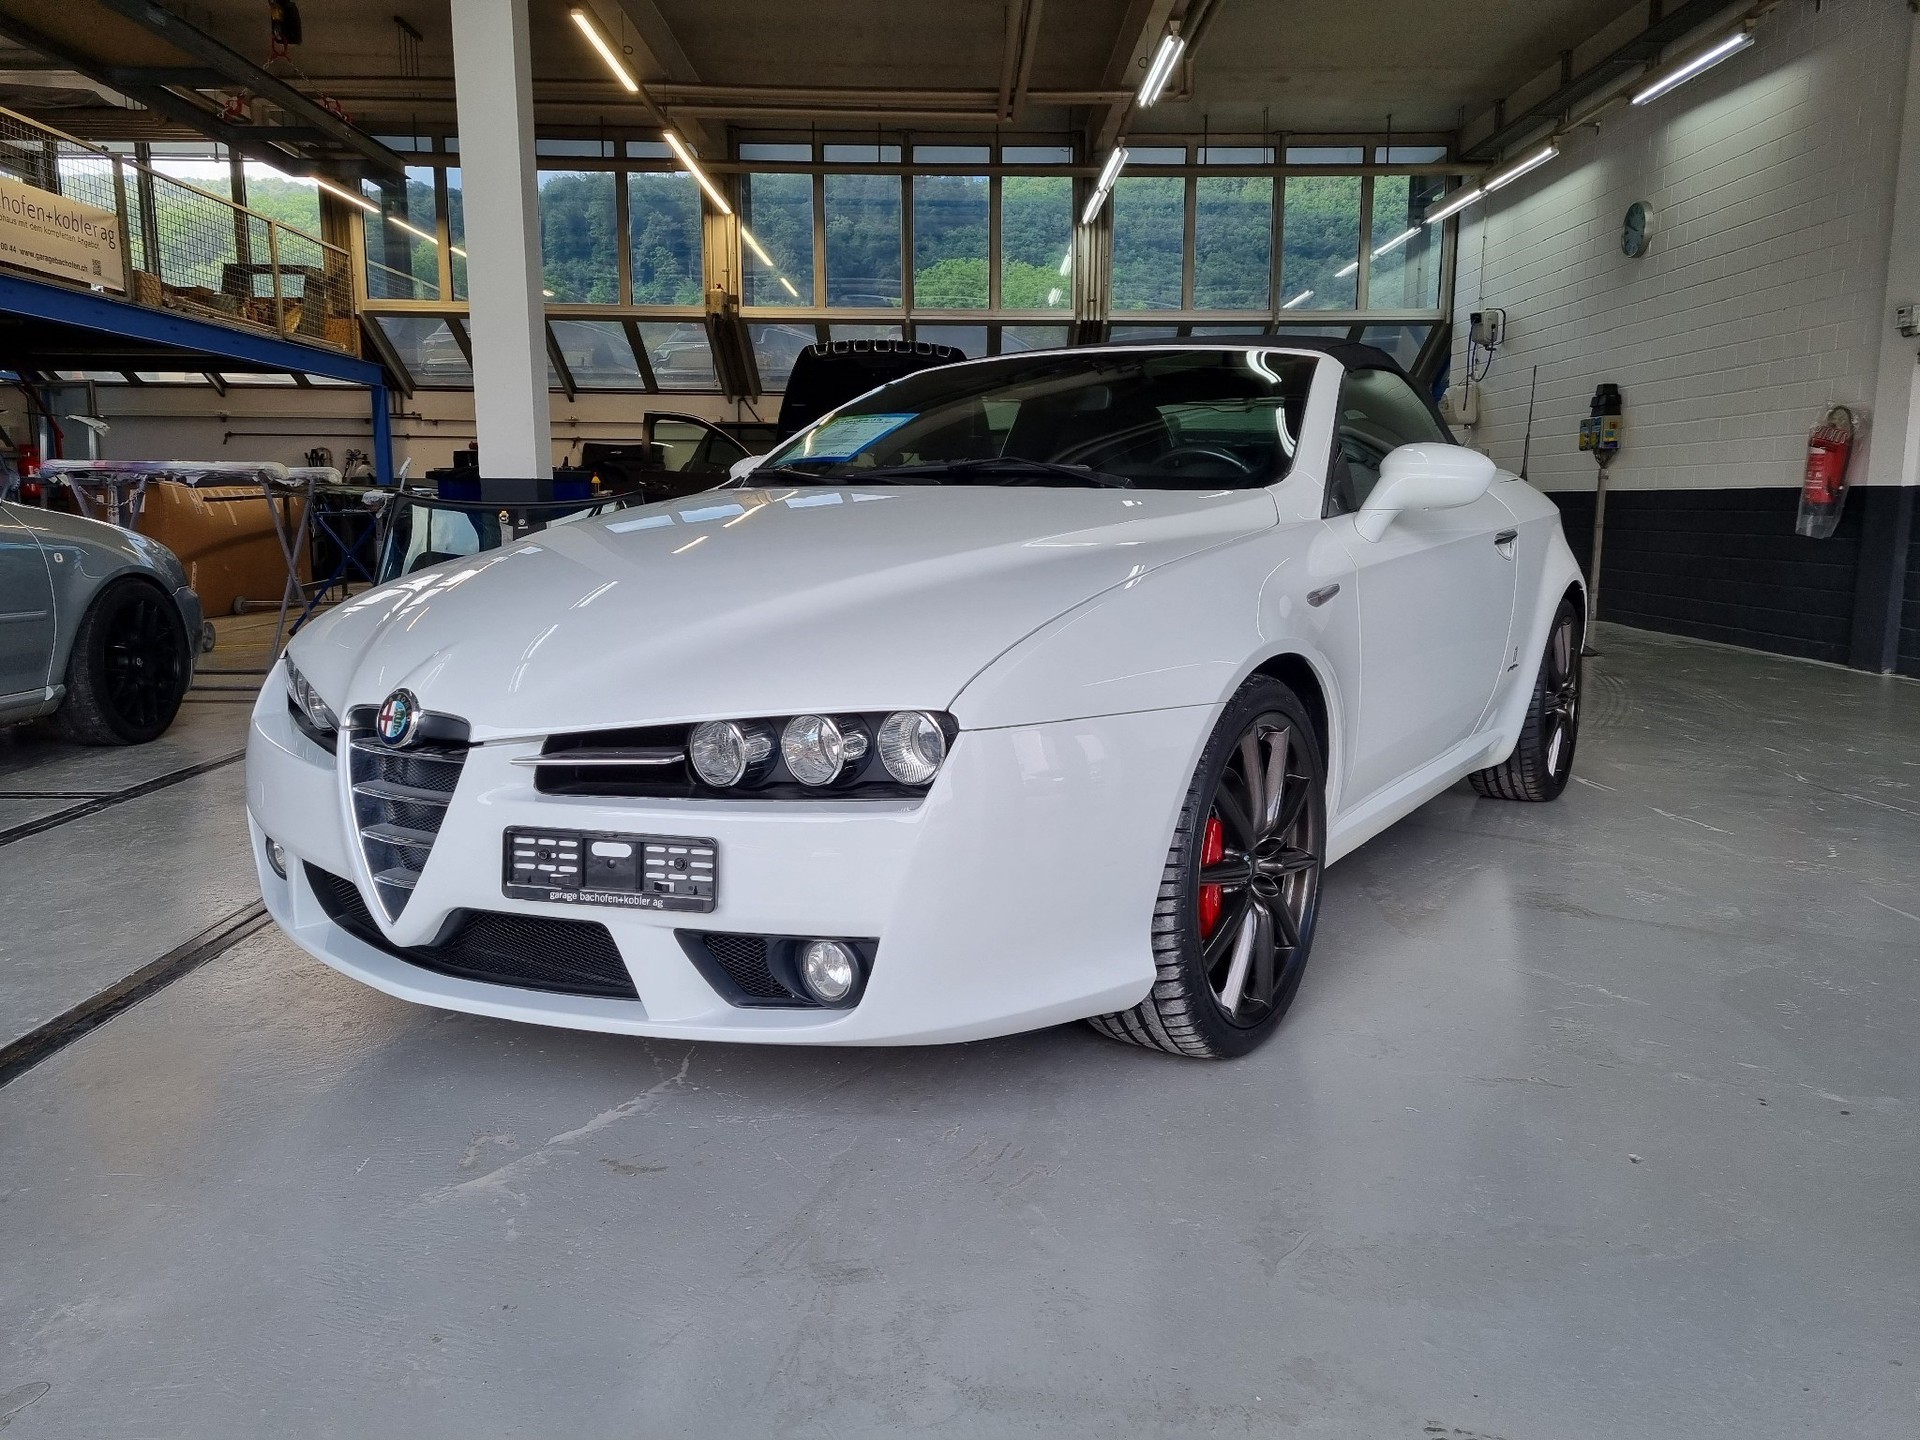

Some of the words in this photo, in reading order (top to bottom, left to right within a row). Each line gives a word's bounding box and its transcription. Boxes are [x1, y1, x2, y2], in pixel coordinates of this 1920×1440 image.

[0, 187, 98, 237] hofen+kobler
[100, 227, 116, 249] ag
[9, 244, 17, 253] 44
[549, 891, 577, 901] garage
[579, 892, 651, 906] bachofen+kobler
[652, 899, 664, 908] ag
